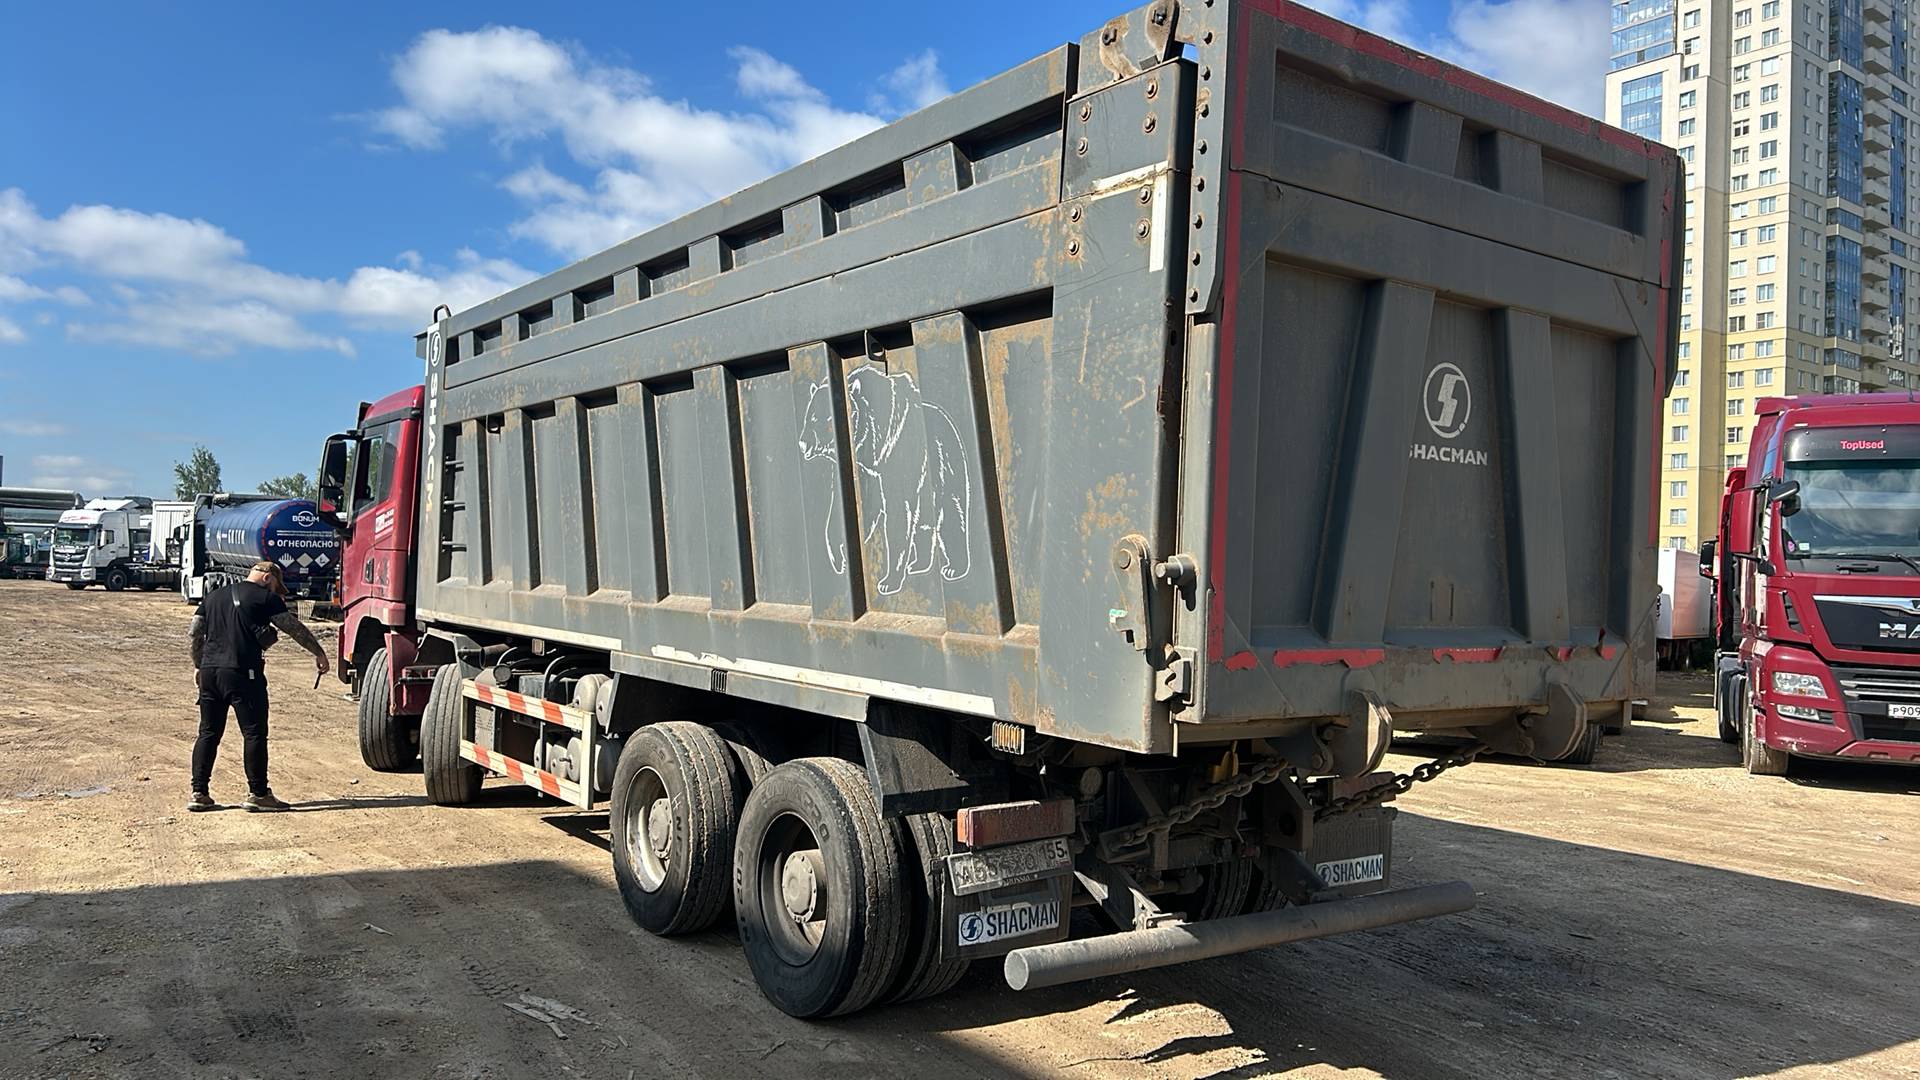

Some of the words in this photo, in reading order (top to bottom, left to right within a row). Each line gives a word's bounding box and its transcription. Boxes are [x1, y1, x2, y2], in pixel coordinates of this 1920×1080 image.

[1841, 440, 1884, 451] TopUsed
[292, 515, 319, 523] BONUM
[276, 539, 333, 548] ОГНЕОПАСНО
[1332, 858, 1383, 883] SHACMAN
[986, 901, 1059, 937] SHACMAN
